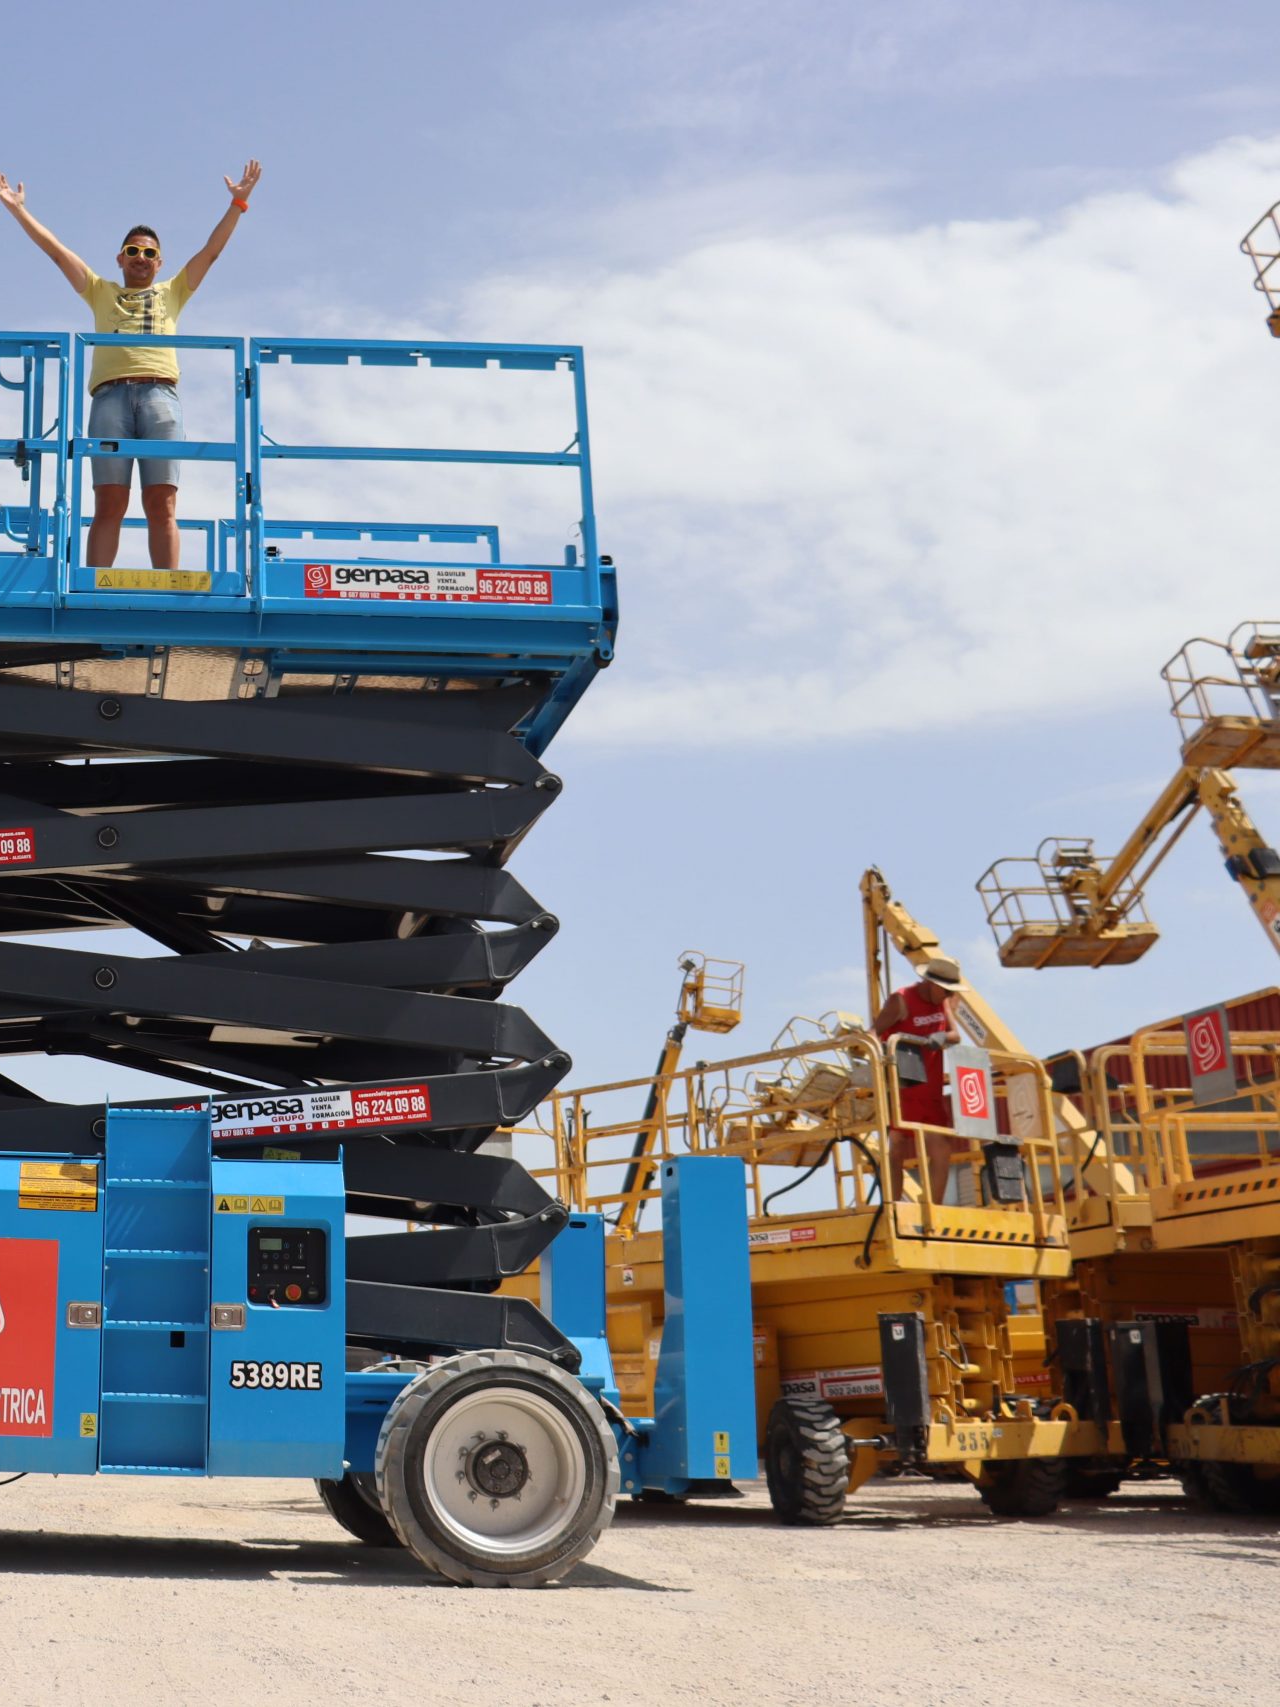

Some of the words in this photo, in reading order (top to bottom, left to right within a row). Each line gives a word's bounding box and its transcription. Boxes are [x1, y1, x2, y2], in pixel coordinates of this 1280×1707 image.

[335, 567, 429, 586] gerpasa
[479, 579, 493, 594] 96
[495, 580, 516, 594] 224
[518, 580, 532, 595] 09
[534, 581, 548, 595] 88
[0, 839, 15, 854] 09
[16, 838, 31, 853] 88
[311, 1095, 340, 1103] ALQUILER
[354, 1101, 369, 1117] 96
[371, 1099, 393, 1115] 224
[394, 1097, 409, 1113] 09
[410, 1096, 426, 1111] 88
[210, 1098, 305, 1123] gerpasa
[271, 1114, 305, 1123] GRUPO
[312, 1110, 351, 1119] FORMACIÓN
[230, 1361, 322, 1389] 5389RE
